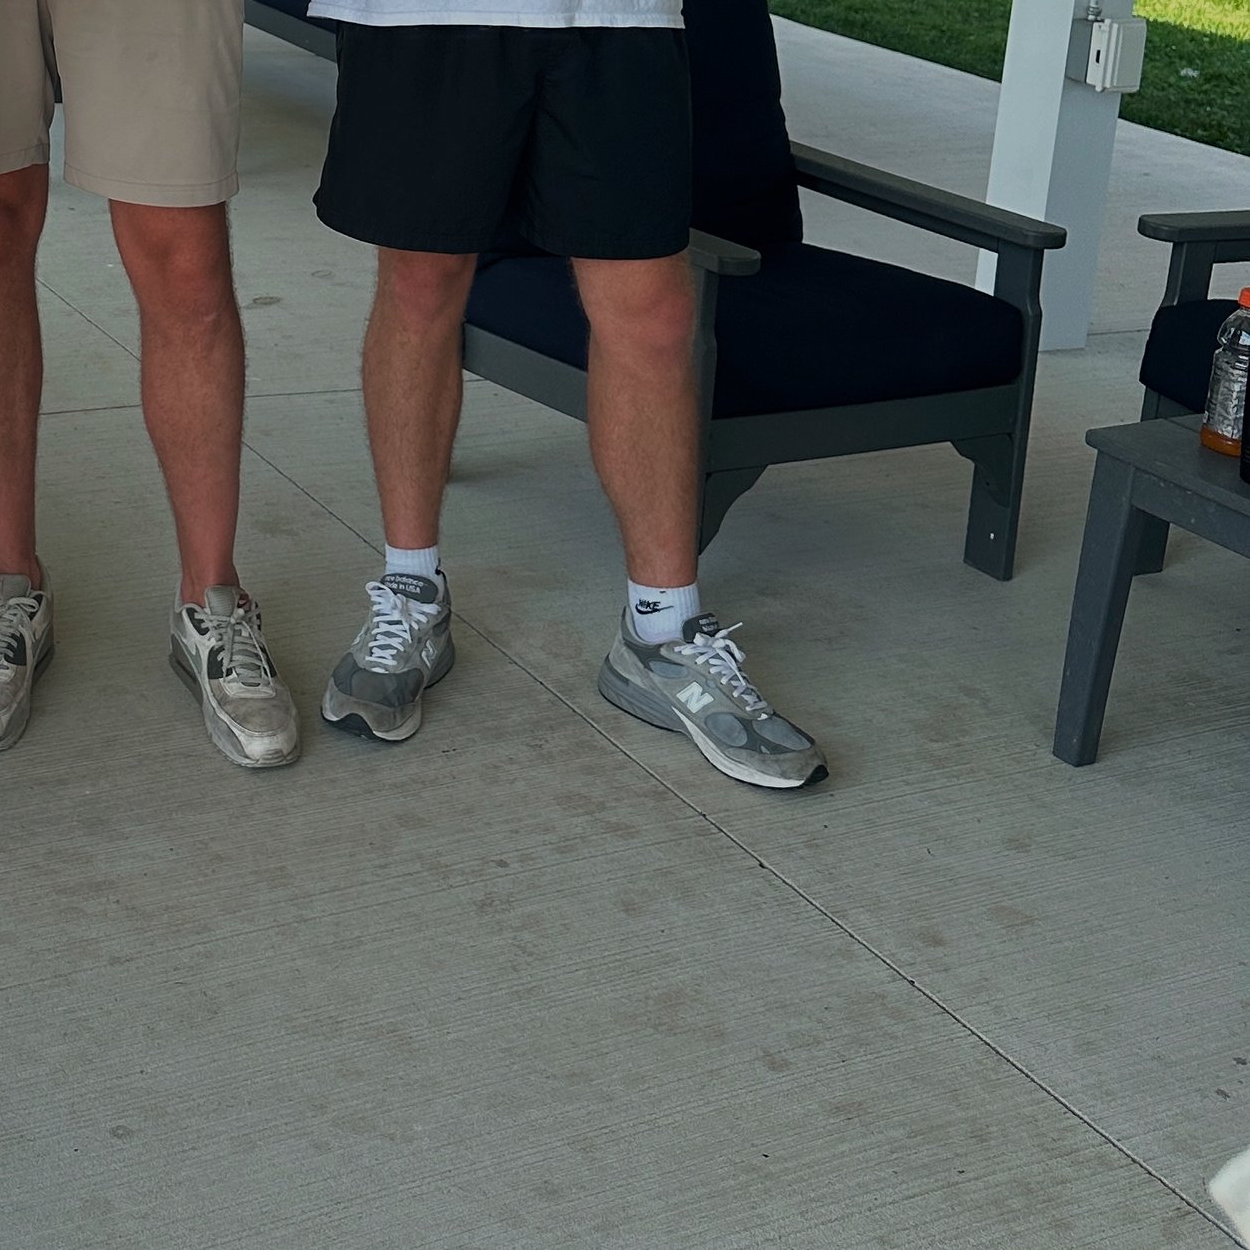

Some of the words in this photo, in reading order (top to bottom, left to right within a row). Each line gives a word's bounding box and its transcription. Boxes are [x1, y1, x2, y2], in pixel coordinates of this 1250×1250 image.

[396, 576, 424, 587] balance
[406, 584, 421, 594] USA
[638, 598, 661, 610] NIKE
